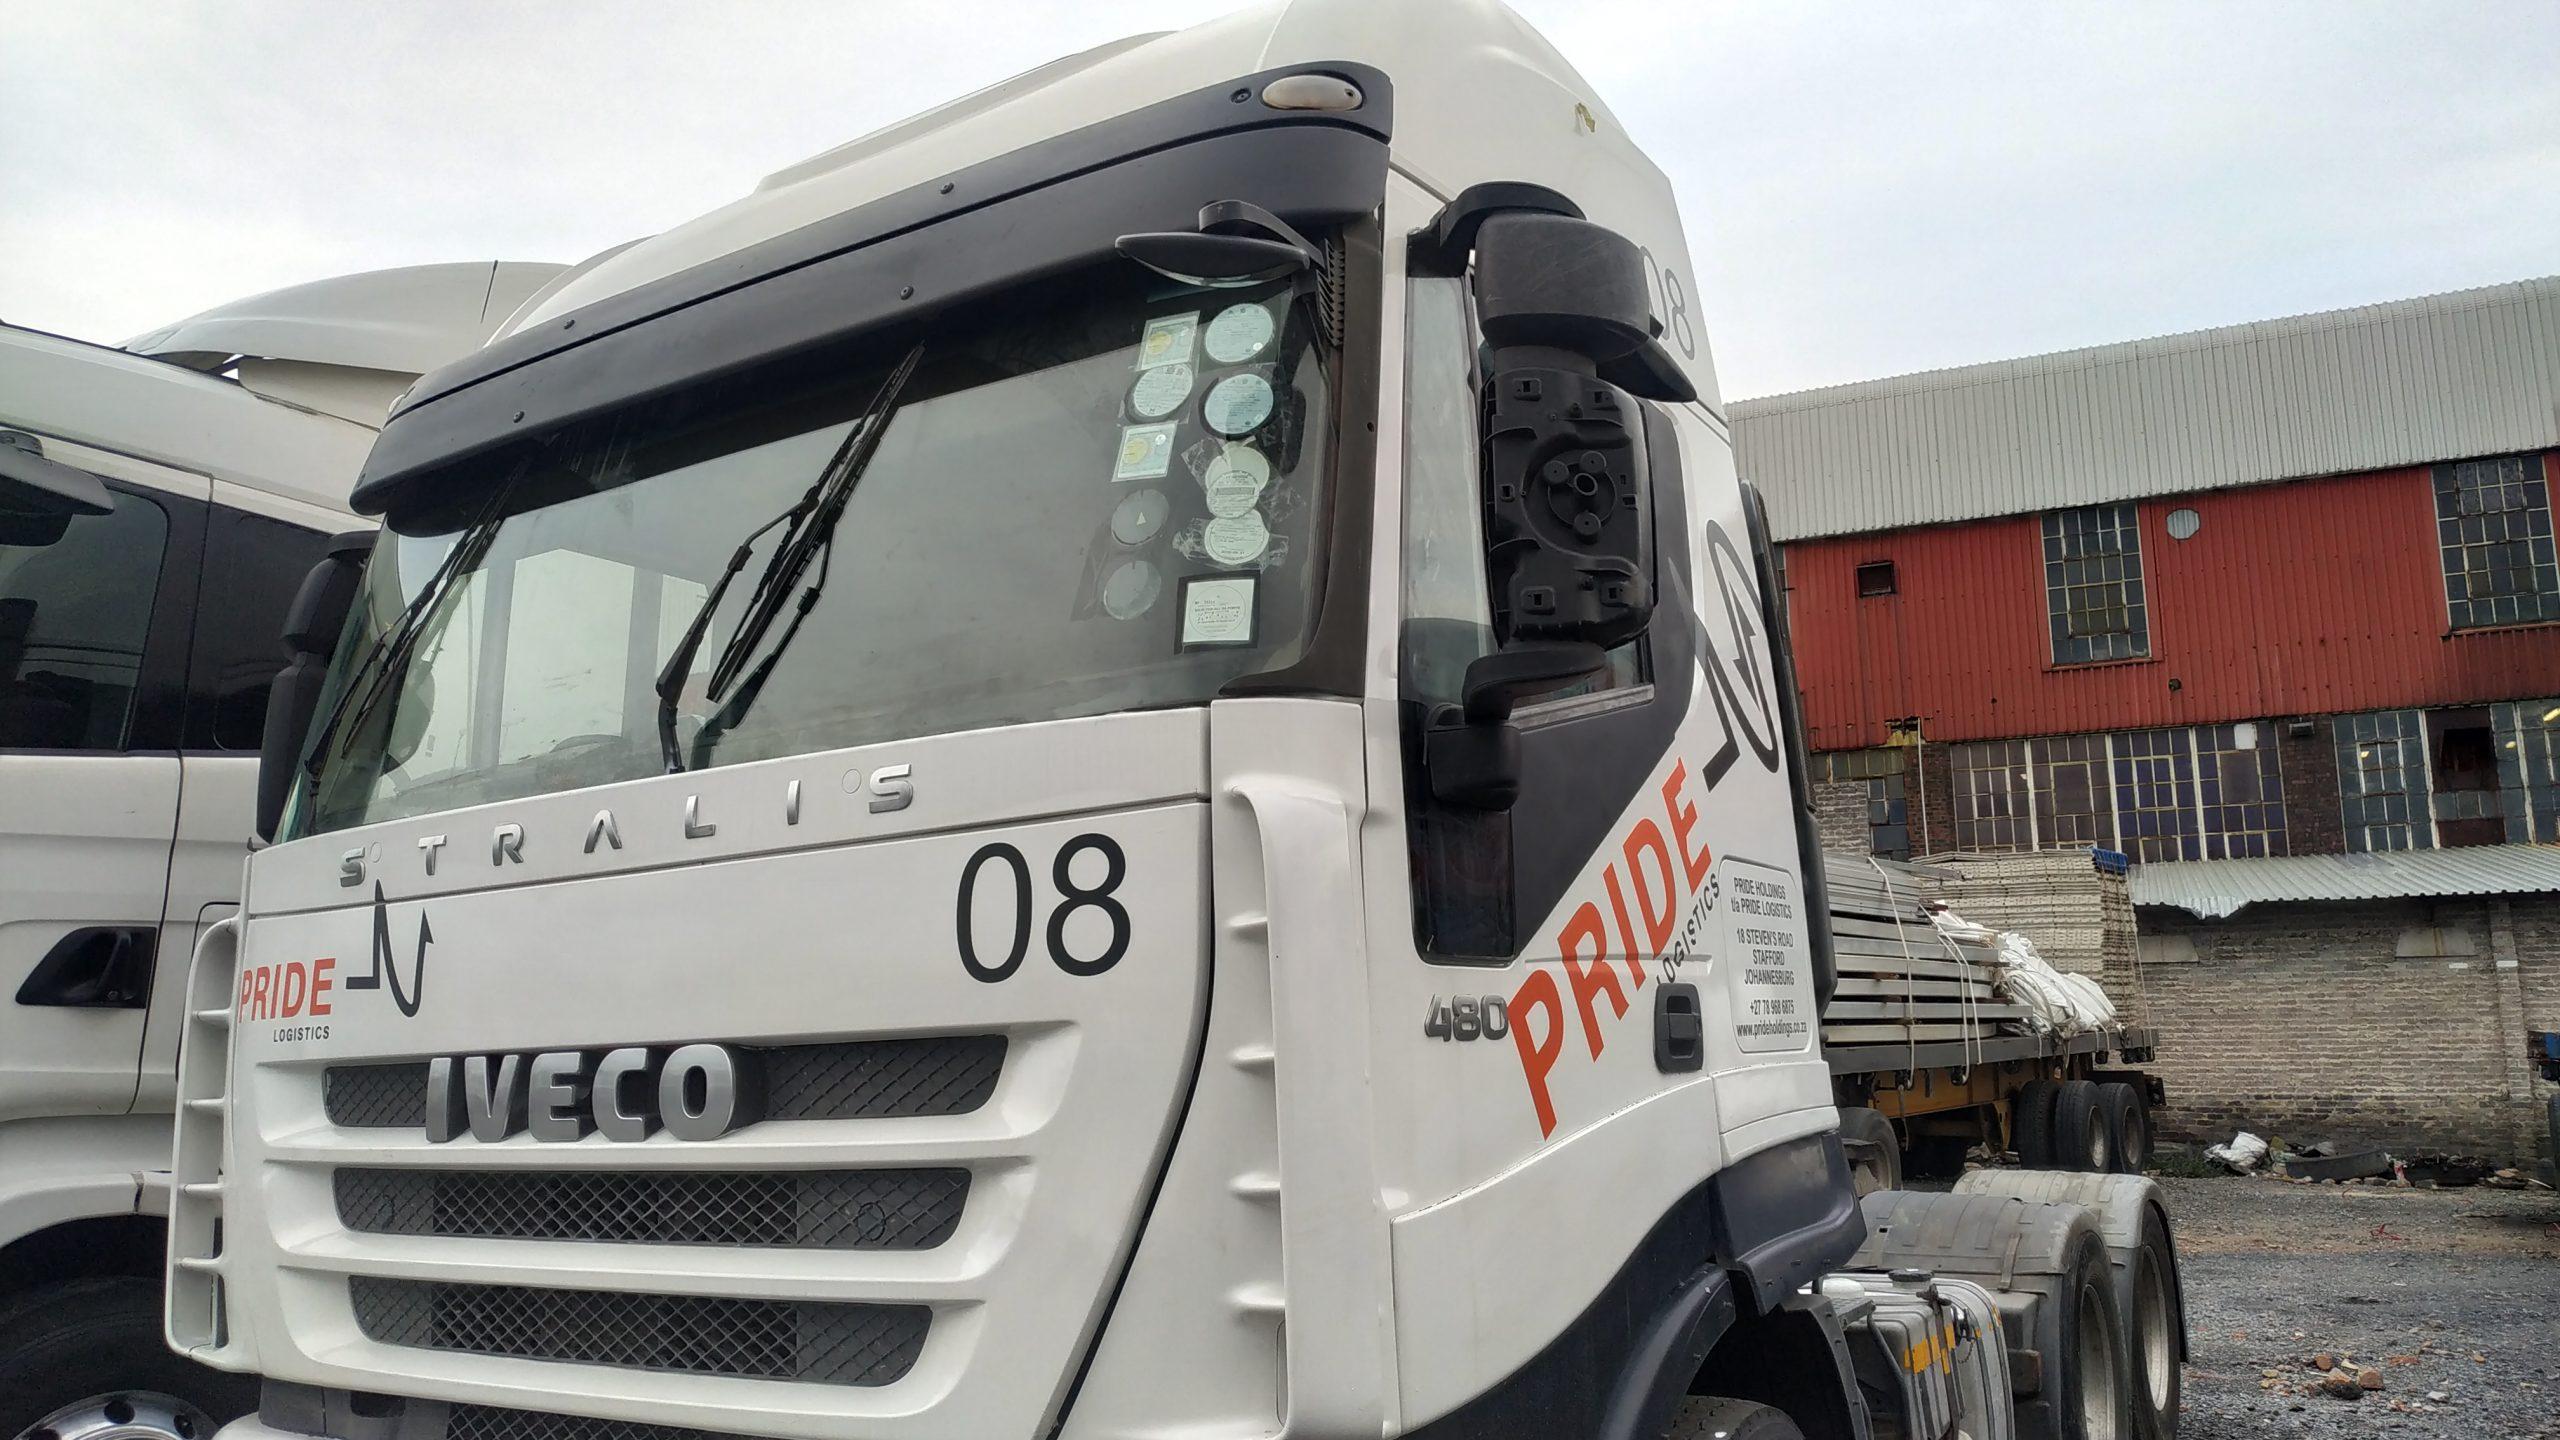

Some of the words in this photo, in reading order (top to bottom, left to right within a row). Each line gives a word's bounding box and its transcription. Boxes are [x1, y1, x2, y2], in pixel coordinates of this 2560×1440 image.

[1640, 245, 1695, 361] 08
[338, 763, 915, 888] STRALIS
[1733, 876, 1754, 897] PRIDE
[1755, 880, 1786, 900] HOLDINGS
[955, 832, 1132, 984] 08
[1741, 897, 1761, 917] PRIDE
[1761, 900, 1793, 920] LOGISTICS
[1506, 756, 1713, 1143] PRIDE
[1736, 927, 1745, 943] 18
[1746, 928, 1777, 947] STEVEN'S
[1777, 931, 1794, 948] ROAD
[1752, 949, 1785, 966] STAFFORD
[1744, 968, 1795, 986] JOHANNESBURG
[238, 957, 336, 1024] PRIDE
[1424, 993, 1509, 1042] 480
[1750, 1000, 1761, 1015] +27
[1762, 1000, 1770, 1015] 78
[1771, 1000, 1781, 1015] 968
[1782, 999, 1795, 1015] 6875
[273, 1025, 330, 1043] LOGISTICS
[1736, 1020, 1808, 1040] www.prideholdings.co.za
[425, 1043, 742, 1144] IVECO
